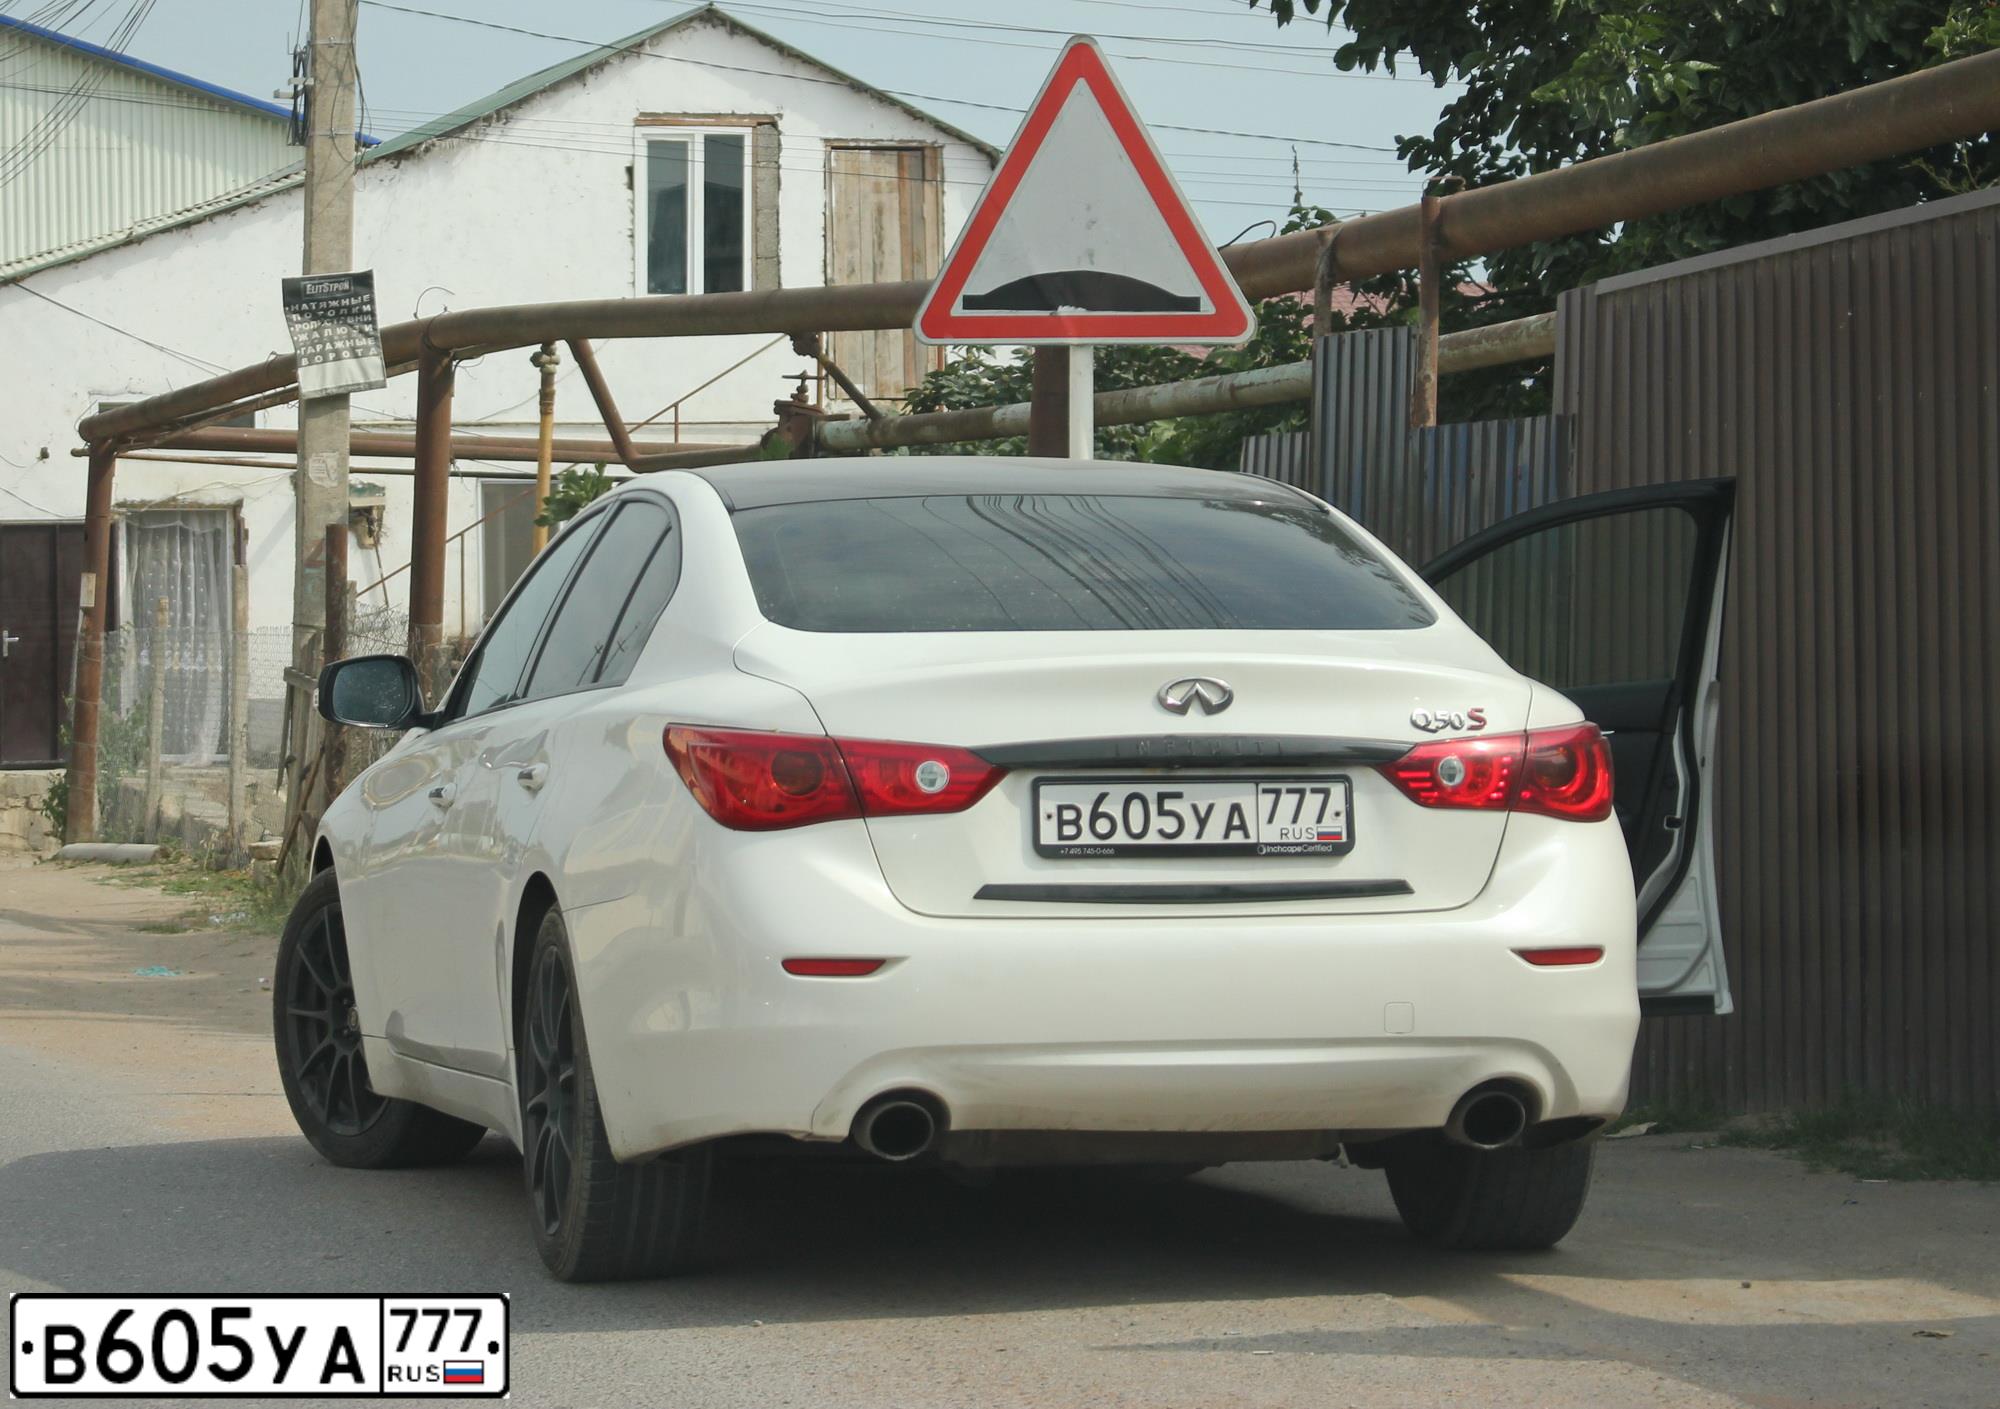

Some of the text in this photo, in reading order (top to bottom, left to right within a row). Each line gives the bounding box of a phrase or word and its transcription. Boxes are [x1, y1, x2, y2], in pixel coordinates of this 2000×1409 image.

[290, 294, 370, 311] НАТЯЖНЫЕ
[300, 337, 376, 355] ГАРАЖНЫЕ
[301, 347, 377, 366] ВОРОТА
[1262, 787, 1331, 825] 777
[1280, 827, 1315, 840] RUS
